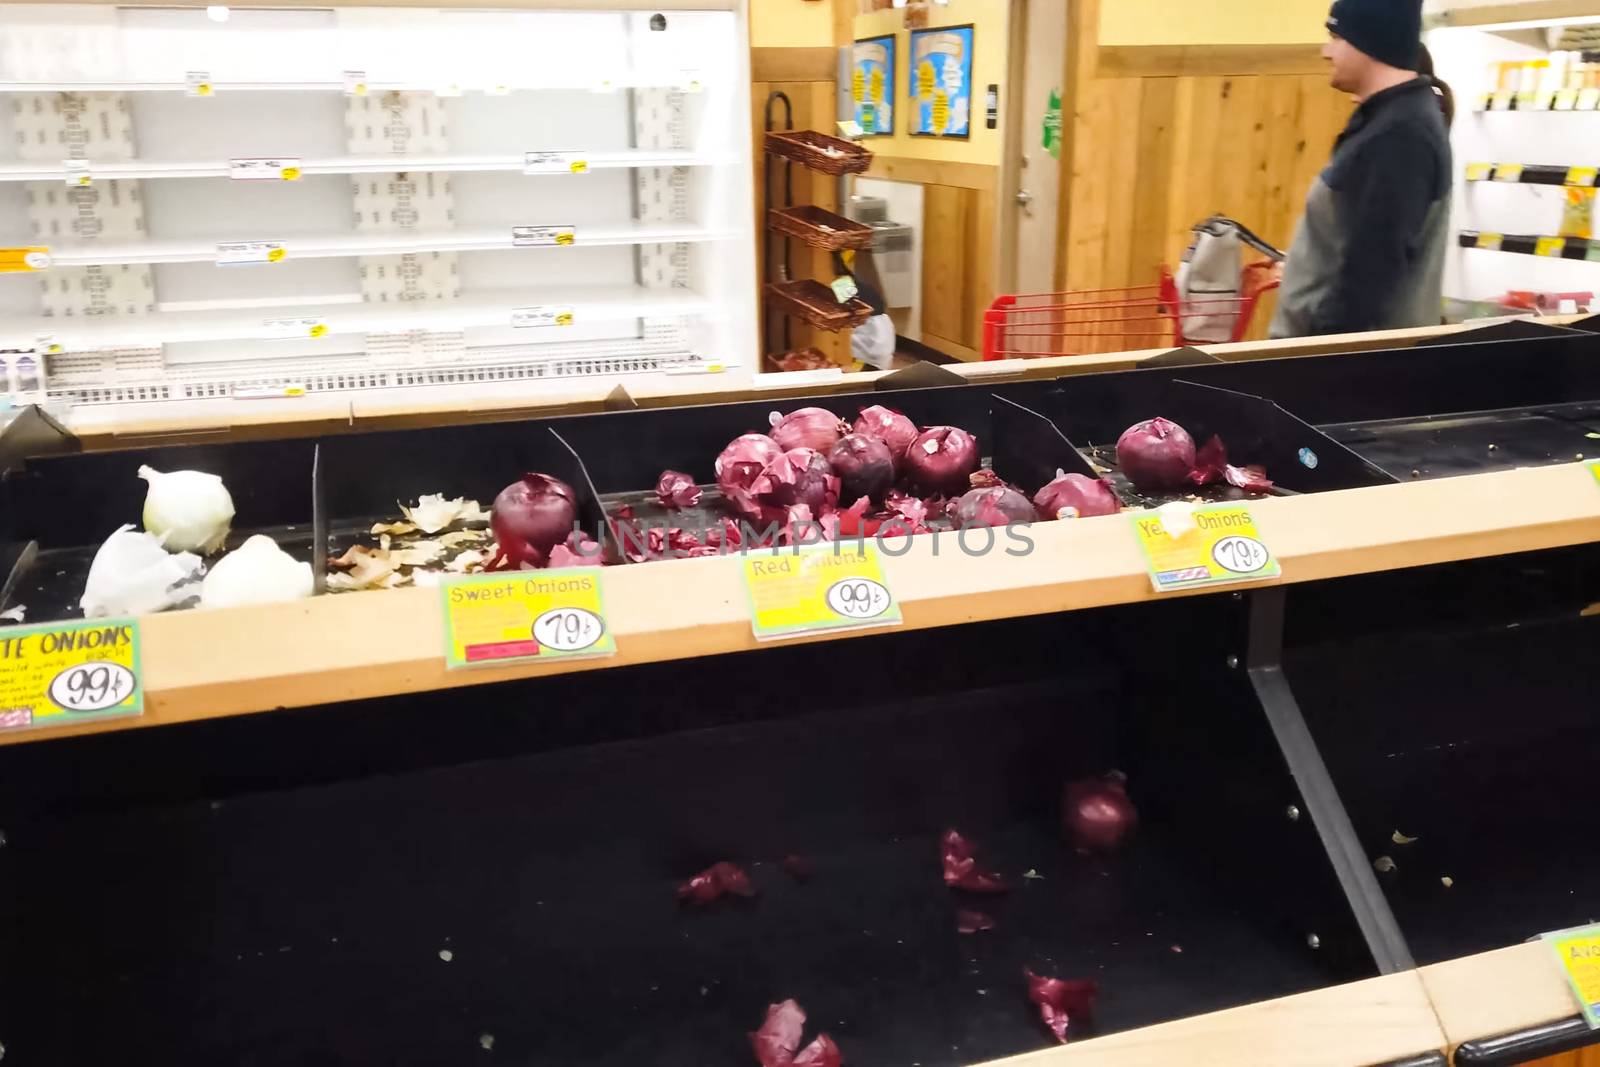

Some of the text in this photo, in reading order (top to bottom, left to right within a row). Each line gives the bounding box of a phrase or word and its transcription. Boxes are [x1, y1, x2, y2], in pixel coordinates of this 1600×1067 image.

[1196, 511, 1252, 530] Onions
[753, 557, 791, 576] Red
[451, 577, 592, 603] Sweet Onions
[41, 625, 132, 655] ONIONS
